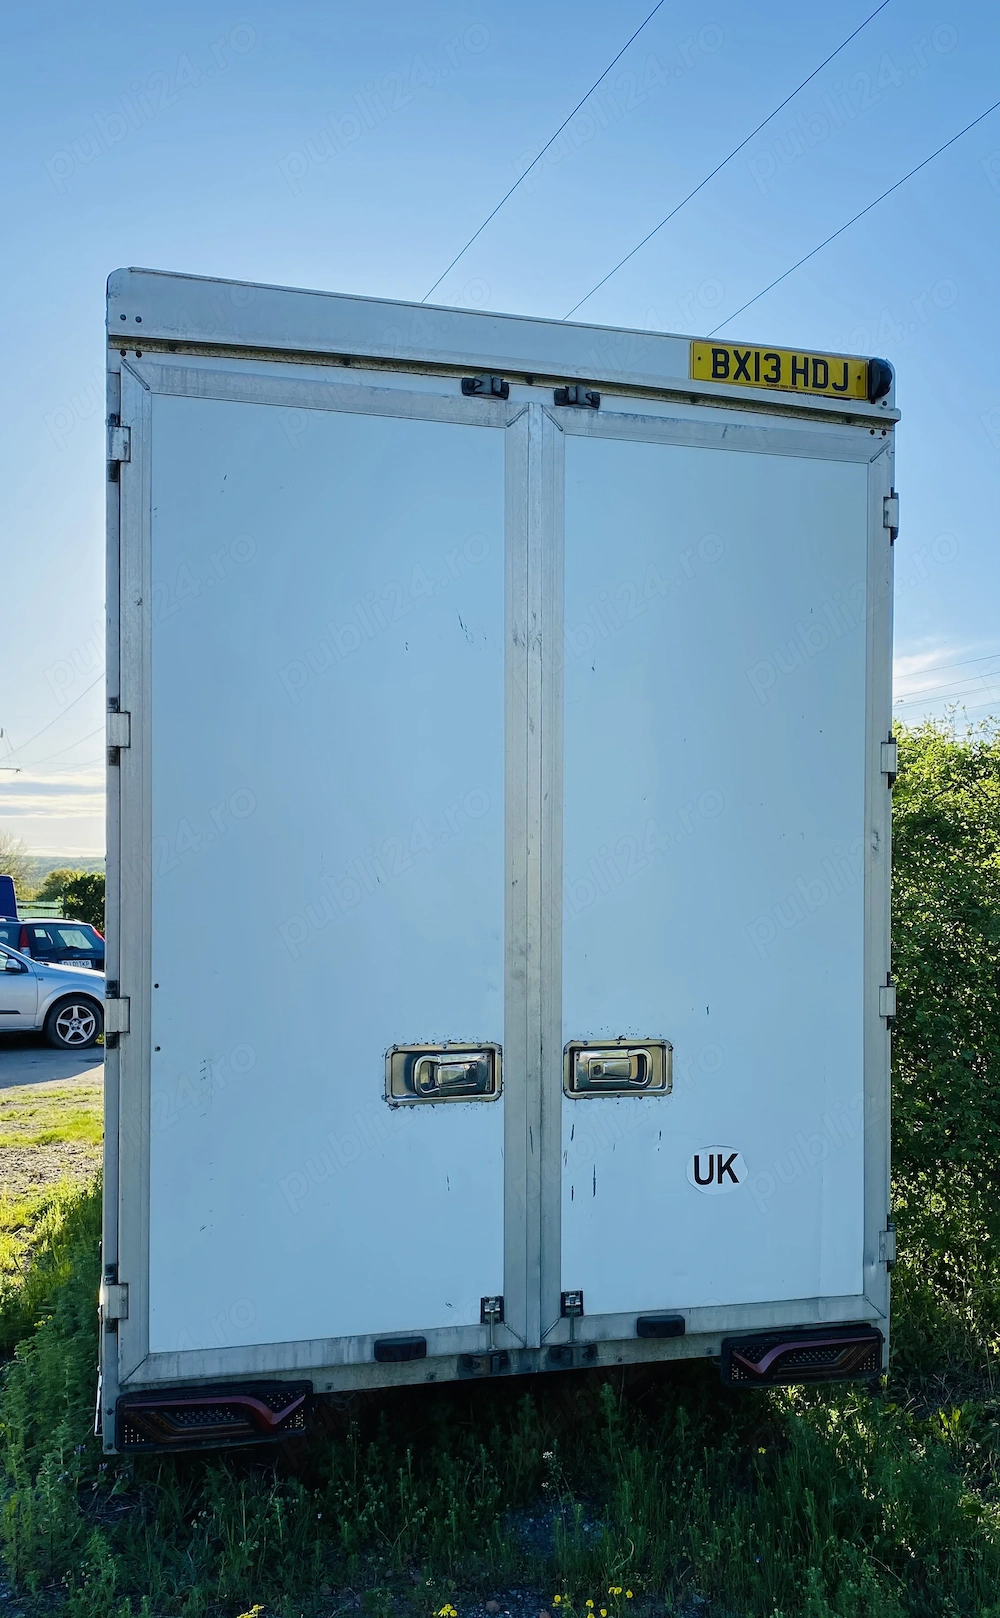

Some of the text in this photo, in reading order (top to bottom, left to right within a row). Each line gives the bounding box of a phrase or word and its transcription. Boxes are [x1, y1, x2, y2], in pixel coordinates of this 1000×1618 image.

[711, 348, 849, 392] BX13 HDJ
[693, 1153, 740, 1185] UK
